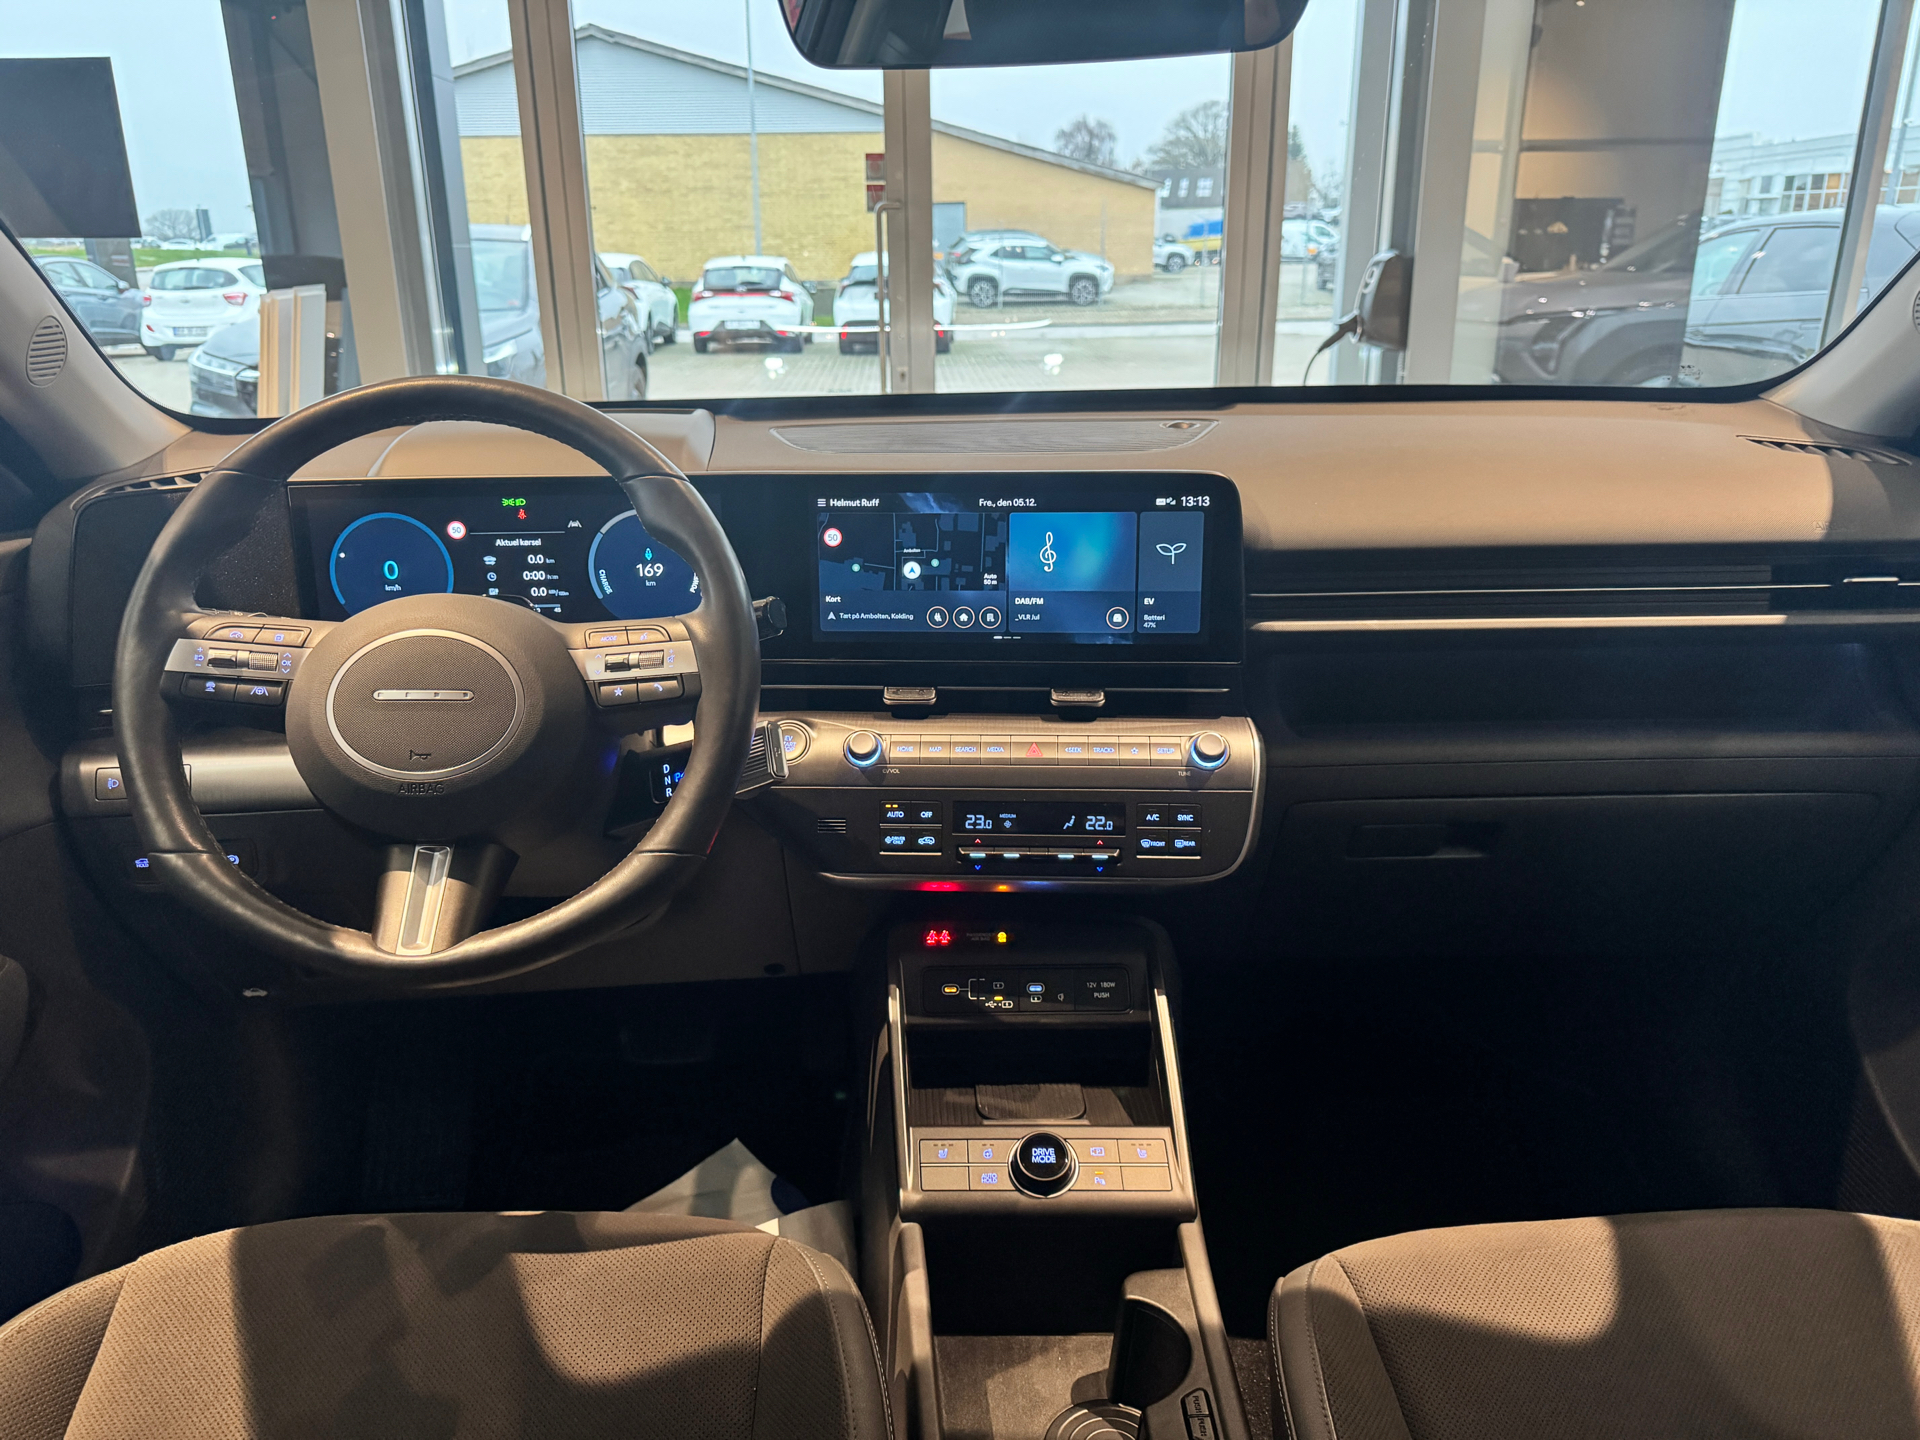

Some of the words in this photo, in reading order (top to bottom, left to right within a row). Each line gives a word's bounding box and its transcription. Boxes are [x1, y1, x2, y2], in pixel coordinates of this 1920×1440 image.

[830, 499, 860, 507] Helmut
[861, 498, 880, 507] Ruff
[979, 498, 996, 508] Fre.,
[997, 498, 1012, 507] den
[1013, 498, 1037, 507] 05.12.
[1181, 496, 1210, 507] 13:13
[828, 534, 838, 542] 50
[496, 539, 519, 547] Aktuel
[527, 554, 544, 564] 0.0
[383, 560, 399, 580] 0
[636, 563, 664, 577] 169
[523, 571, 546, 580] 0:00
[599, 569, 613, 595] CHARGE
[530, 587, 547, 596] 0.0
[1015, 597, 1044, 605] DAB/FM
[852, 612, 860, 621] på
[891, 613, 913, 621] Kolding
[663, 764, 670, 774] D
[664, 776, 671, 785] N
[398, 783, 445, 795] AIRBAG
[666, 788, 673, 797] R
[965, 814, 992, 829] 23.0
[1177, 814, 1194, 822] SYNC
[1086, 816, 1113, 830] 22.0
[1032, 1148, 1055, 1156] DRIVE
